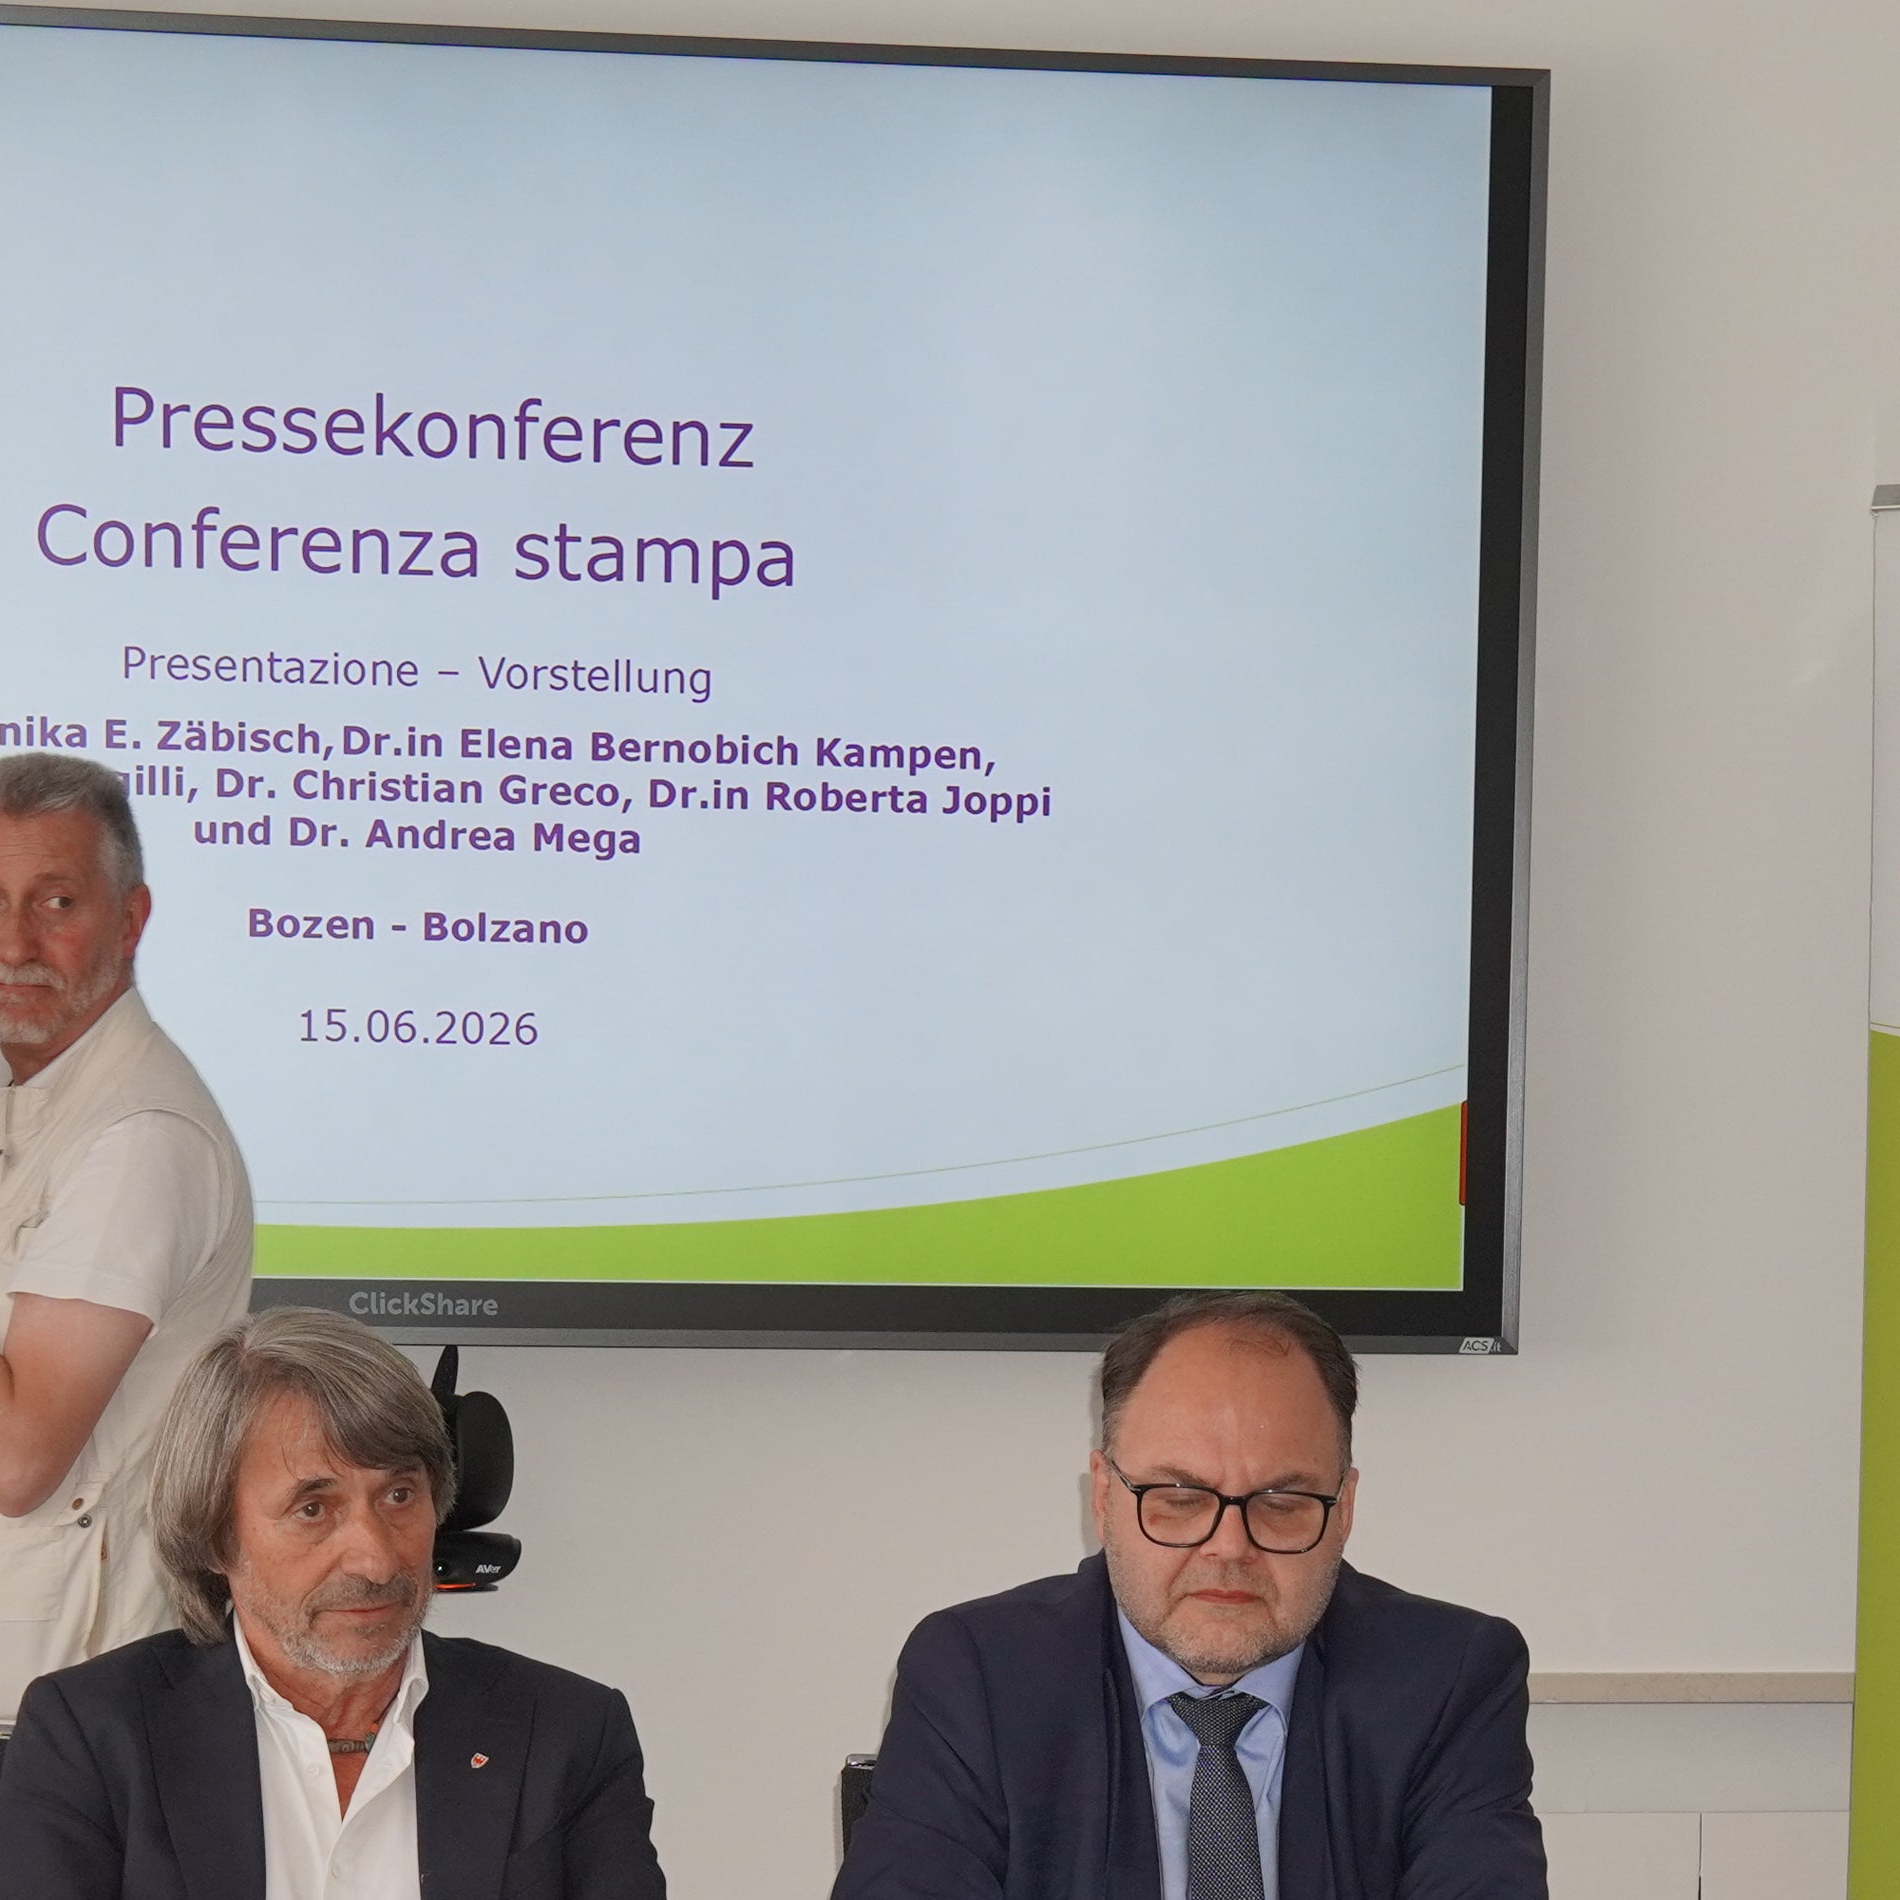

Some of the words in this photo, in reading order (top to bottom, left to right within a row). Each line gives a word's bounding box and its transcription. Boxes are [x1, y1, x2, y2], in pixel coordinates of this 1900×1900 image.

[115, 386, 754, 468] Pressekonferenz
[37, 503, 478, 579] Conferenza
[515, 522, 794, 601] stampa
[124, 645, 419, 687] Presentazione
[477, 655, 711, 704] Vorstellung
[105, 718, 141, 750] E.
[460, 727, 573, 761] Elena
[591, 731, 799, 767] Bernobich
[816, 737, 996, 777] Kampen,
[216, 767, 276, 799] Dr.
[292, 768, 483, 804] Christian
[499, 774, 633, 814] Greco,
[649, 778, 749, 810] Dr.in
[766, 781, 928, 814] Roberta
[942, 785, 1051, 824] Joppi
[194, 814, 271, 846] und
[289, 816, 349, 848] Dr.
[364, 818, 515, 852] Andrea
[533, 822, 641, 862] Mega
[249, 908, 374, 940] Bozen
[423, 911, 589, 945] Bolzano
[300, 1008, 538, 1046] 15.06.2026
[349, 1290, 499, 1317] ClickShare
